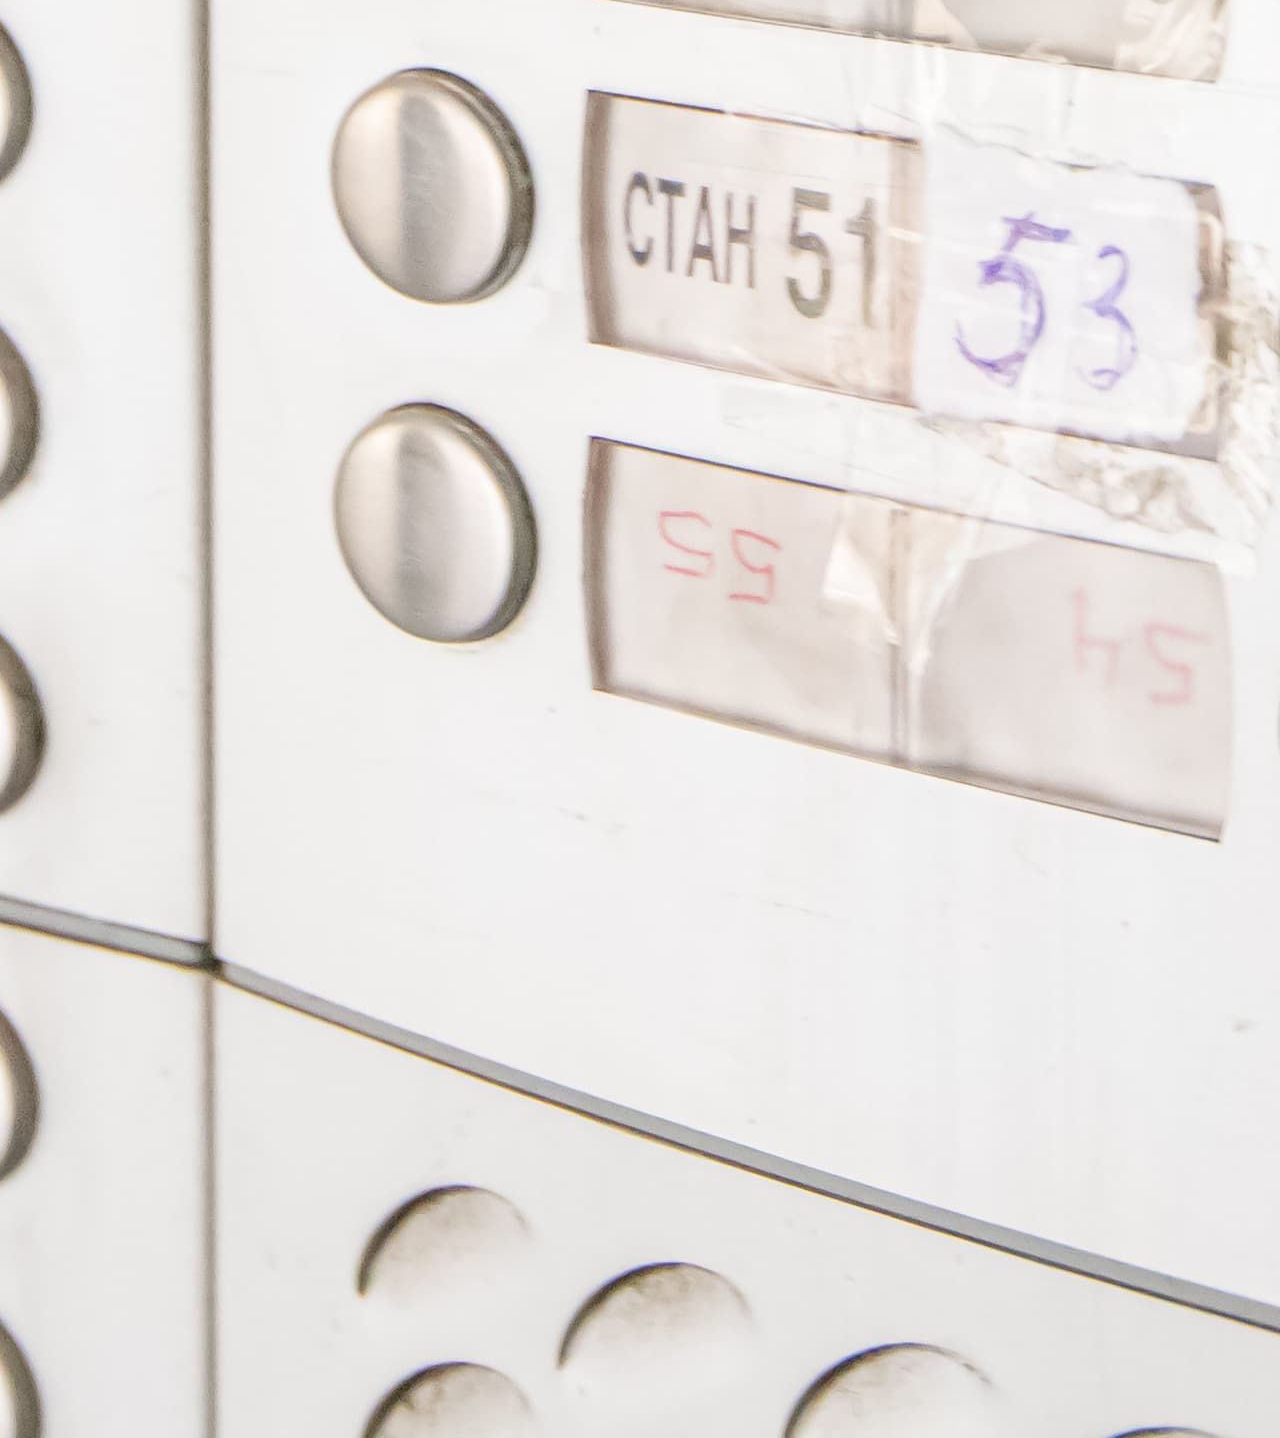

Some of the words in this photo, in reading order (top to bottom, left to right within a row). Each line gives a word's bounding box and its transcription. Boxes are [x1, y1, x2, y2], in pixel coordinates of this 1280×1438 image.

[624, 172, 756, 288] СТАН
[788, 189, 876, 329] 51
[953, 213, 1138, 390] 53
